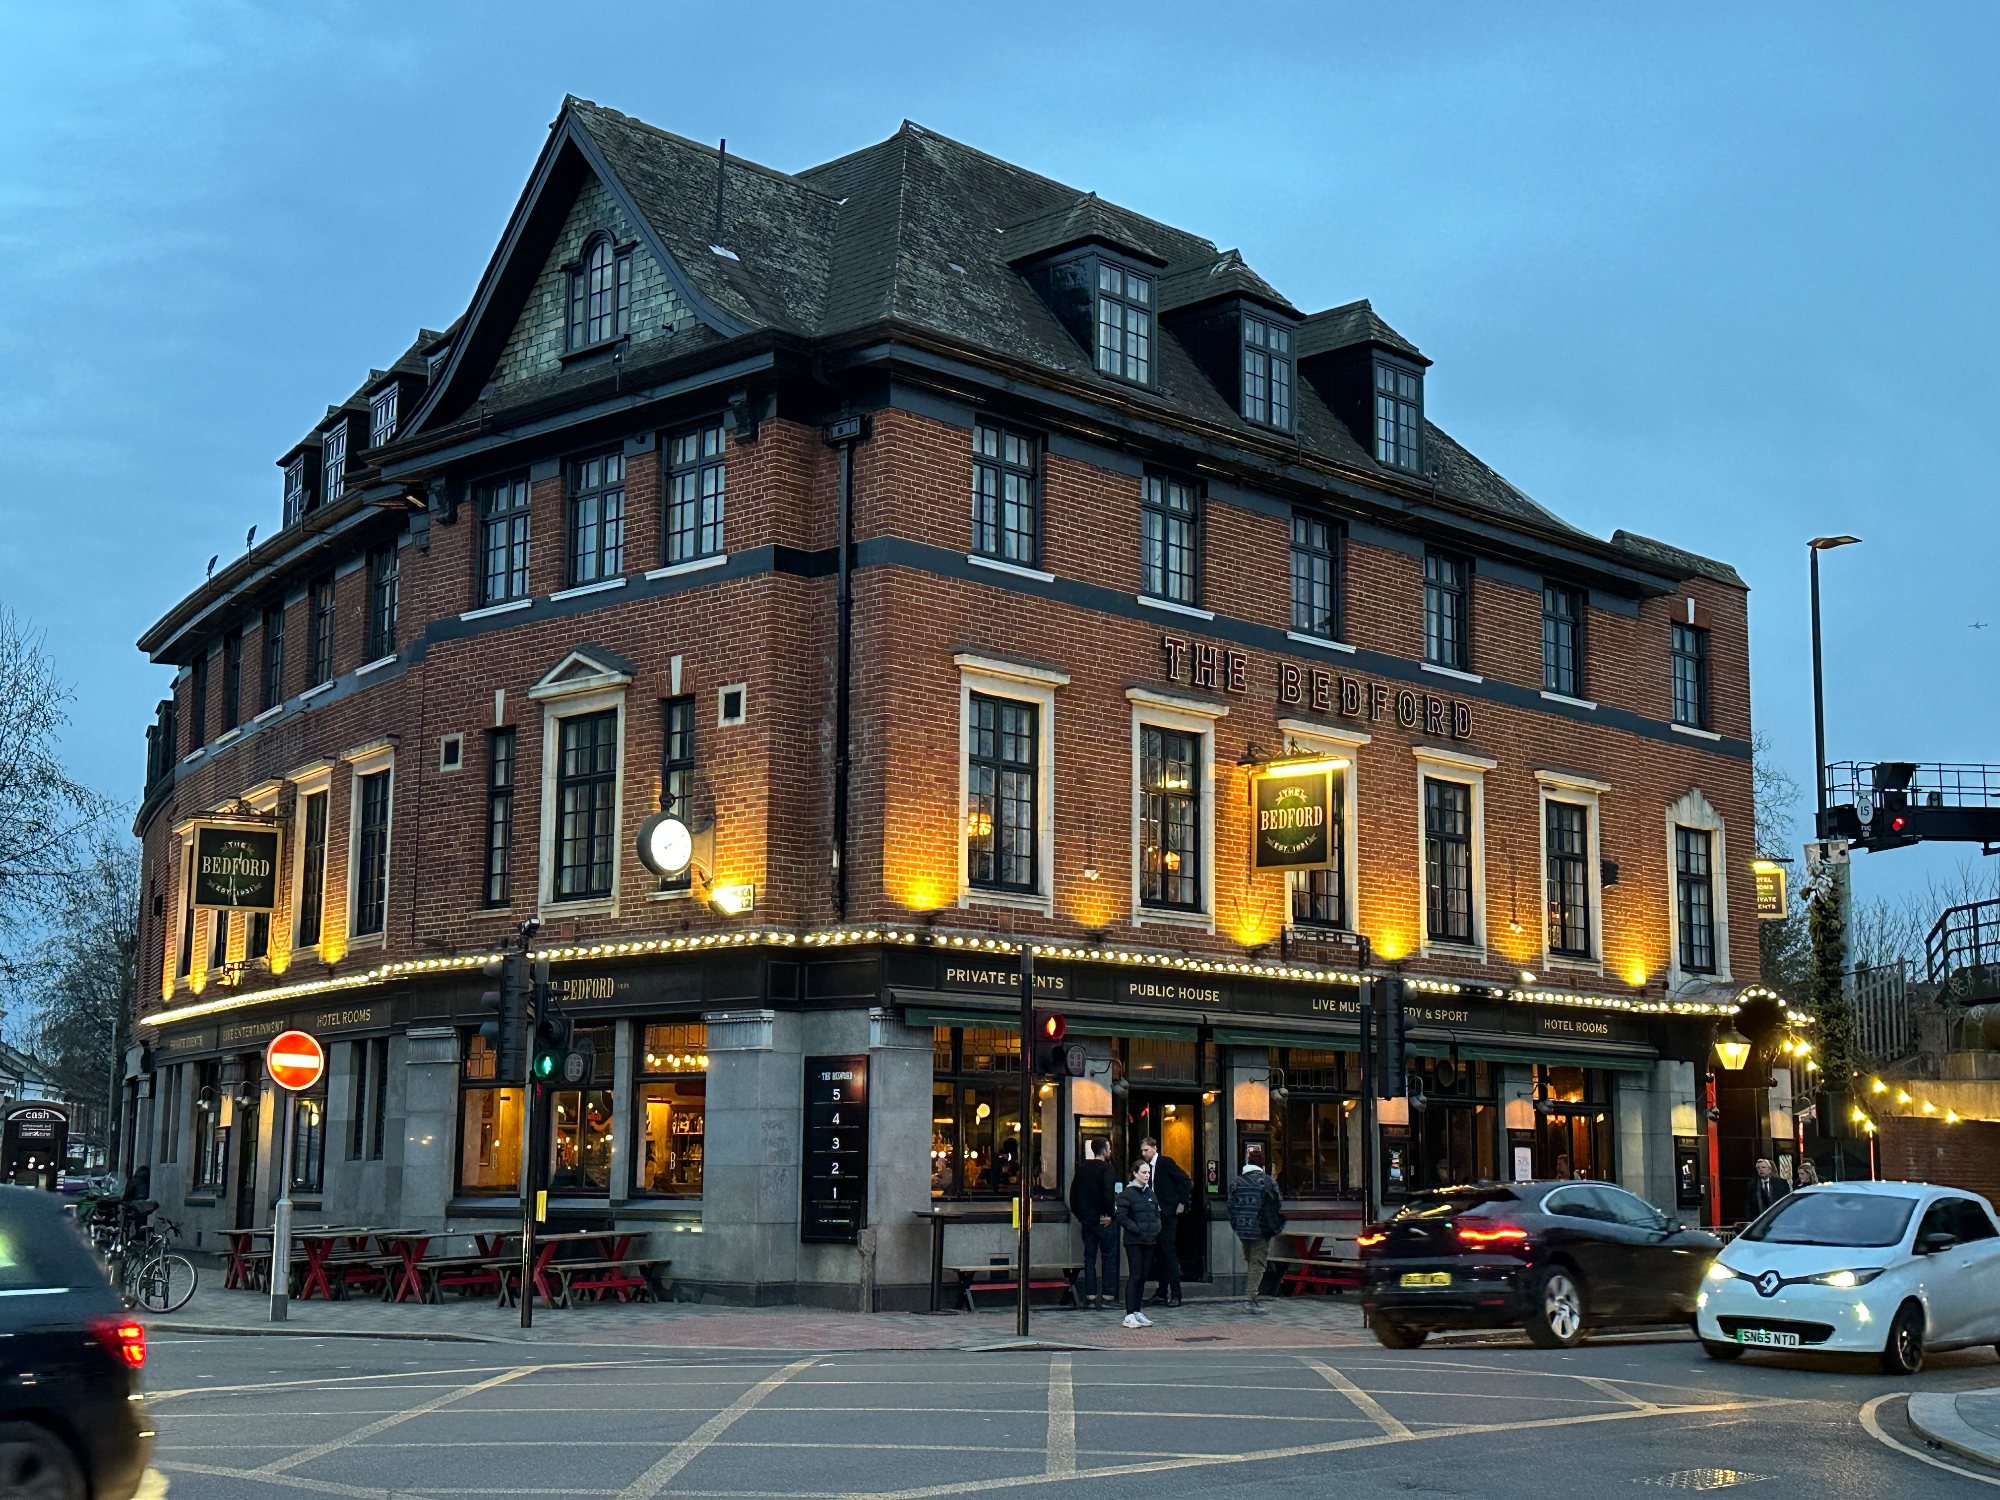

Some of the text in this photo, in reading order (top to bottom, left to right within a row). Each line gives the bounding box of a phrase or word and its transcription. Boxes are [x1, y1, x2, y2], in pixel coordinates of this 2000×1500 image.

[1164, 636, 1473, 739] THE BEDFORD
[1284, 788, 1300, 797] THE
[1860, 805, 1870, 816] LS
[1261, 805, 1323, 831] BEDFORD
[227, 841, 247, 849] THE
[202, 853, 270, 878] BEDFORD
[946, 968, 1064, 990] PRIVATE ENTS
[562, 977, 614, 1001] BEDFORD
[1129, 983, 1220, 1002] PUBLIC HOUSE
[1312, 998, 1336, 1012] LIVE
[1339, 1001, 1361, 1014] MUS
[1425, 1008, 1433, 1020] &
[1434, 1009, 1469, 1022] SPORT
[316, 1008, 371, 1028] HOTEL ROOMS
[1544, 1018, 1609, 1034] HOTEL ROOMS
[832, 1088, 841, 1101] 5
[25, 1109, 50, 1119] cash
[832, 1112, 840, 1125] 4
[831, 1137, 840, 1150] 3
[831, 1162, 840, 1175] 2
[832, 1187, 837, 1200] 1
